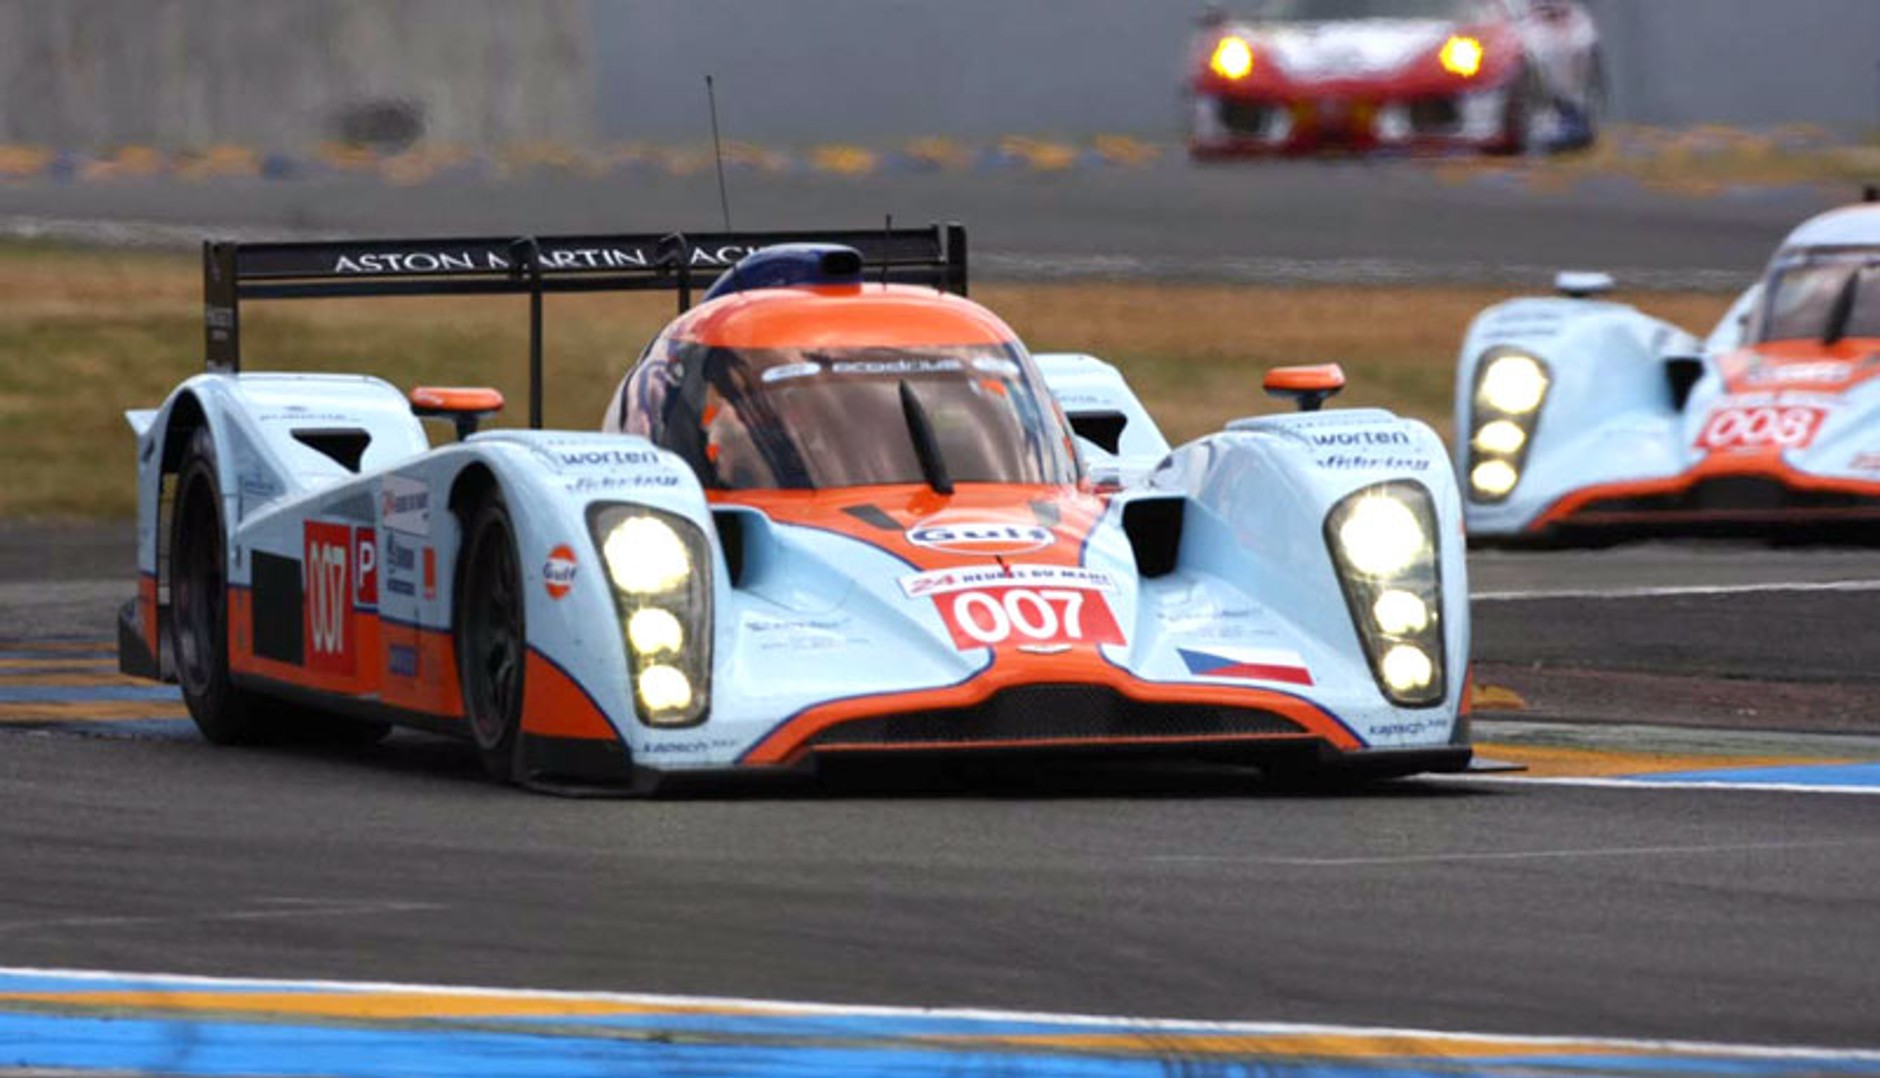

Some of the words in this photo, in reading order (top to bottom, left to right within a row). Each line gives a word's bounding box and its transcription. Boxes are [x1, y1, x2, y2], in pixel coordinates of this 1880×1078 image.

[335, 252, 473, 272] ASTON
[1706, 408, 1812, 445] 008
[1312, 431, 1410, 446] worten
[561, 450, 659, 465] worten
[912, 527, 1046, 541] Gulf
[543, 560, 577, 581] Gulf
[910, 575, 955, 593] 24
[309, 538, 345, 654] 007
[953, 589, 1084, 643] 007
